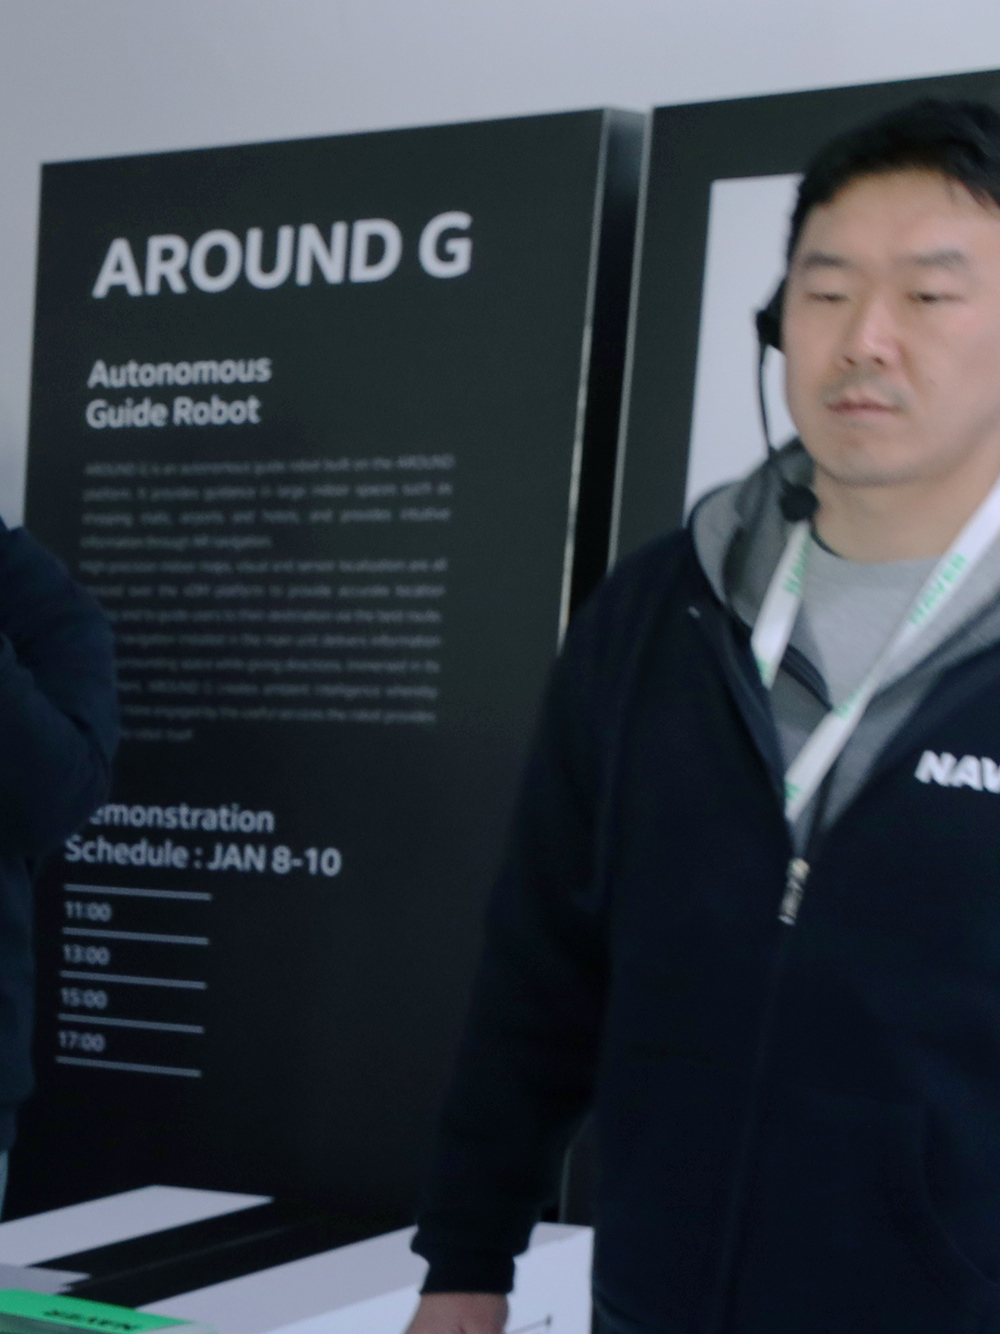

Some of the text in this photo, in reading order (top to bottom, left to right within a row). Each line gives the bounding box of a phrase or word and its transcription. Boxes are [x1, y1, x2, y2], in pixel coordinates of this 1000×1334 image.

[92, 210, 473, 299] AROUND G
[86, 356, 273, 389] Autonomous
[85, 395, 261, 429] Guide Robot
[89, 803, 275, 833] emonstration
[65, 834, 188, 869] Schedule
[207, 843, 267, 873] JAN
[271, 845, 343, 877] 8-10
[64, 900, 112, 922] 11:00
[63, 944, 111, 966] 13:00
[60, 987, 108, 1010] 15:00
[58, 1030, 106, 1053] 17:00
